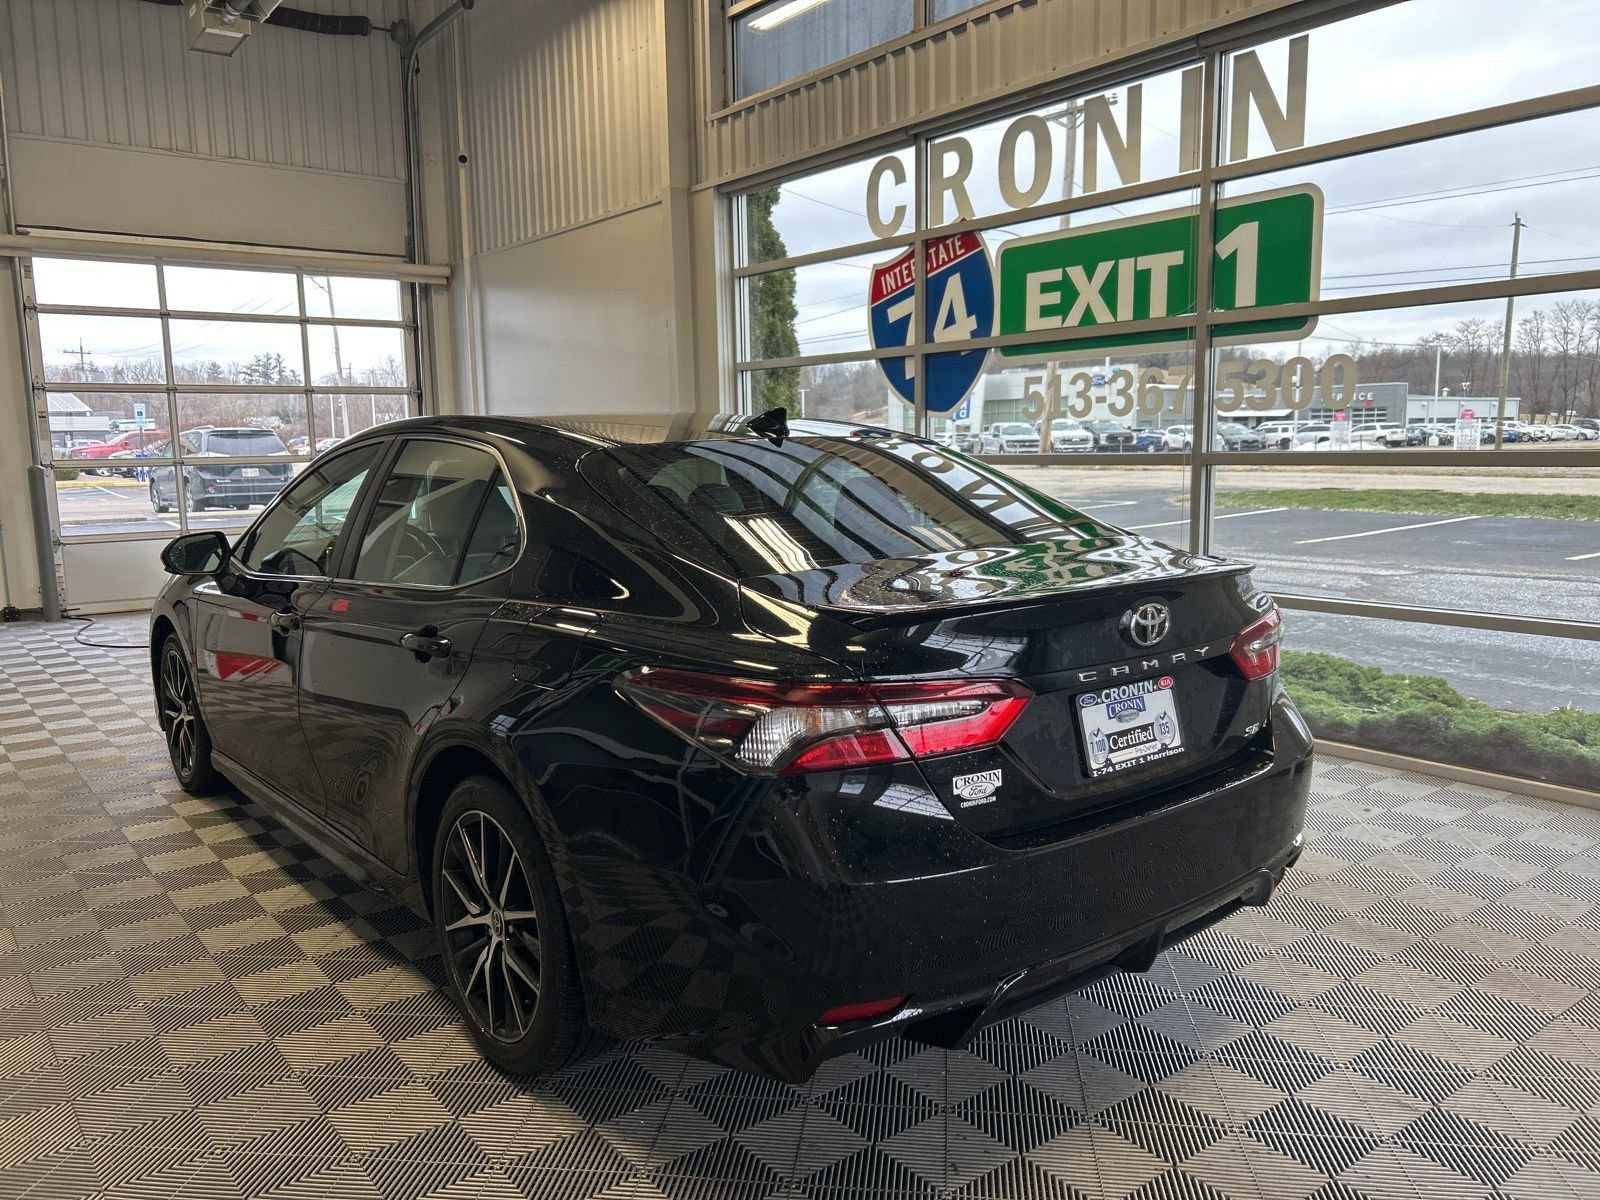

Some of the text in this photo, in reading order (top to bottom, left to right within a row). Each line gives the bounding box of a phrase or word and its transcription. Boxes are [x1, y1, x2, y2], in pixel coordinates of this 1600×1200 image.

[866, 33, 1310, 239] CRONIN
[881, 234, 965, 296] INTETATE
[1026, 221, 1259, 331] EXIT 1
[887, 272, 978, 379] 74
[1078, 646, 1211, 682] CAMRY
[1101, 679, 1154, 703] CRONIN
[1160, 678, 1171, 687] KIA
[1108, 697, 1145, 718] CRONIN
[1109, 725, 1155, 750] Certified
[1158, 721, 1170, 736] 135
[1093, 766, 1114, 778] I-74
[1115, 759, 1137, 770] EXIT
[1147, 747, 1185, 760] Harrison
[955, 770, 1001, 790] CRONIN
[968, 784, 988, 797] Ford
